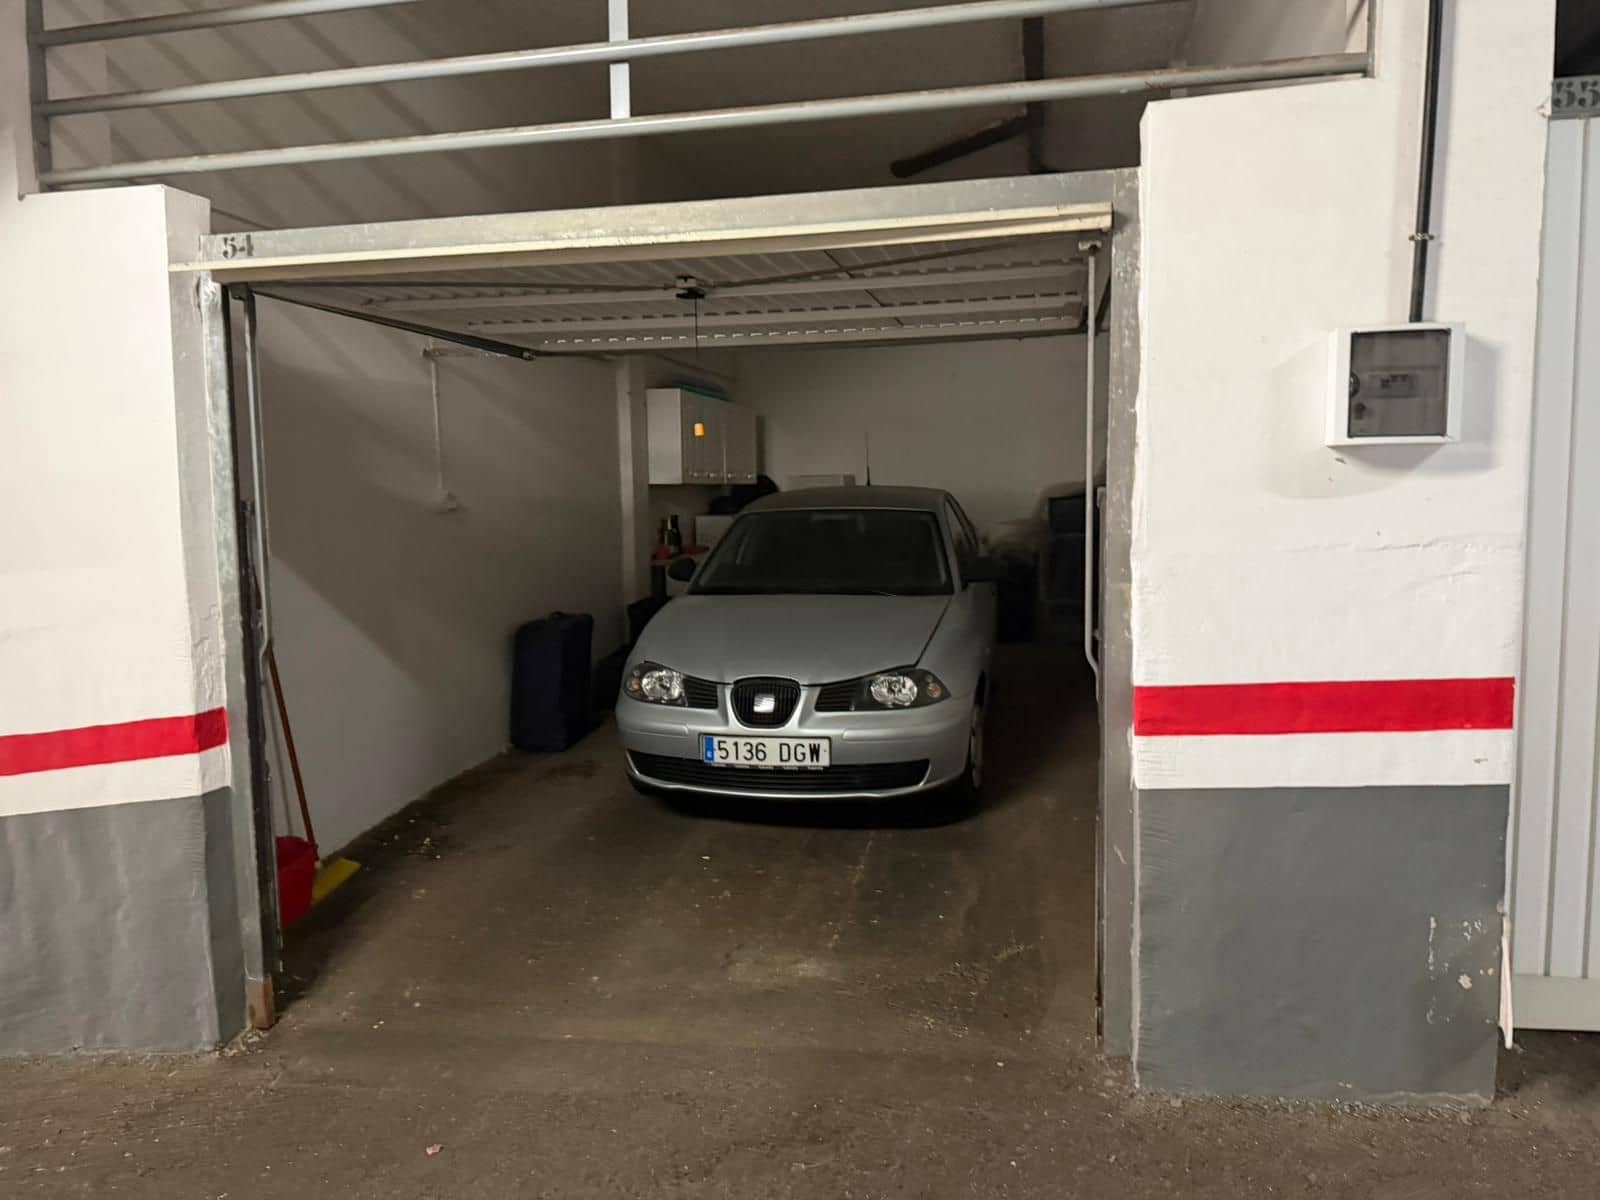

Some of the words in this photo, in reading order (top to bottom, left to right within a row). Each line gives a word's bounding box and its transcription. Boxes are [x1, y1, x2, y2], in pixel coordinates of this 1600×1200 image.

[1553, 80, 1600, 107] 55
[222, 234, 255, 259] 54
[717, 740, 767, 762] 5136
[779, 742, 821, 763] DGW
